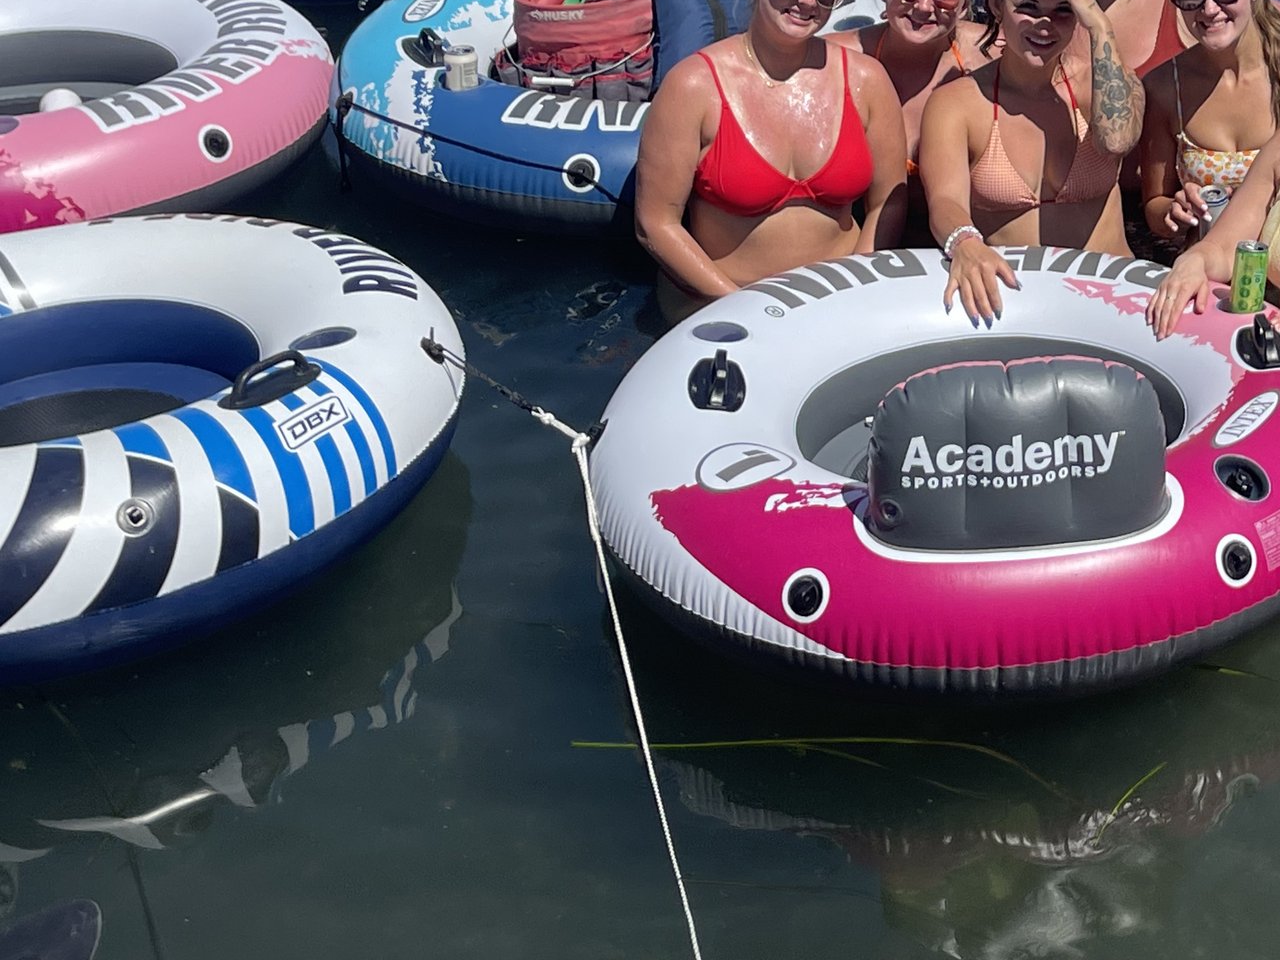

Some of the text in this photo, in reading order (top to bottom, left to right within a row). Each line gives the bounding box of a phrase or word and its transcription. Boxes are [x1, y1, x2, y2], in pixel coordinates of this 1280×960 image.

[542, 10, 584, 21] HUSKY
[286, 402, 341, 441] DBX
[1219, 396, 1275, 438] INTEX
[901, 430, 1119, 474] Academy
